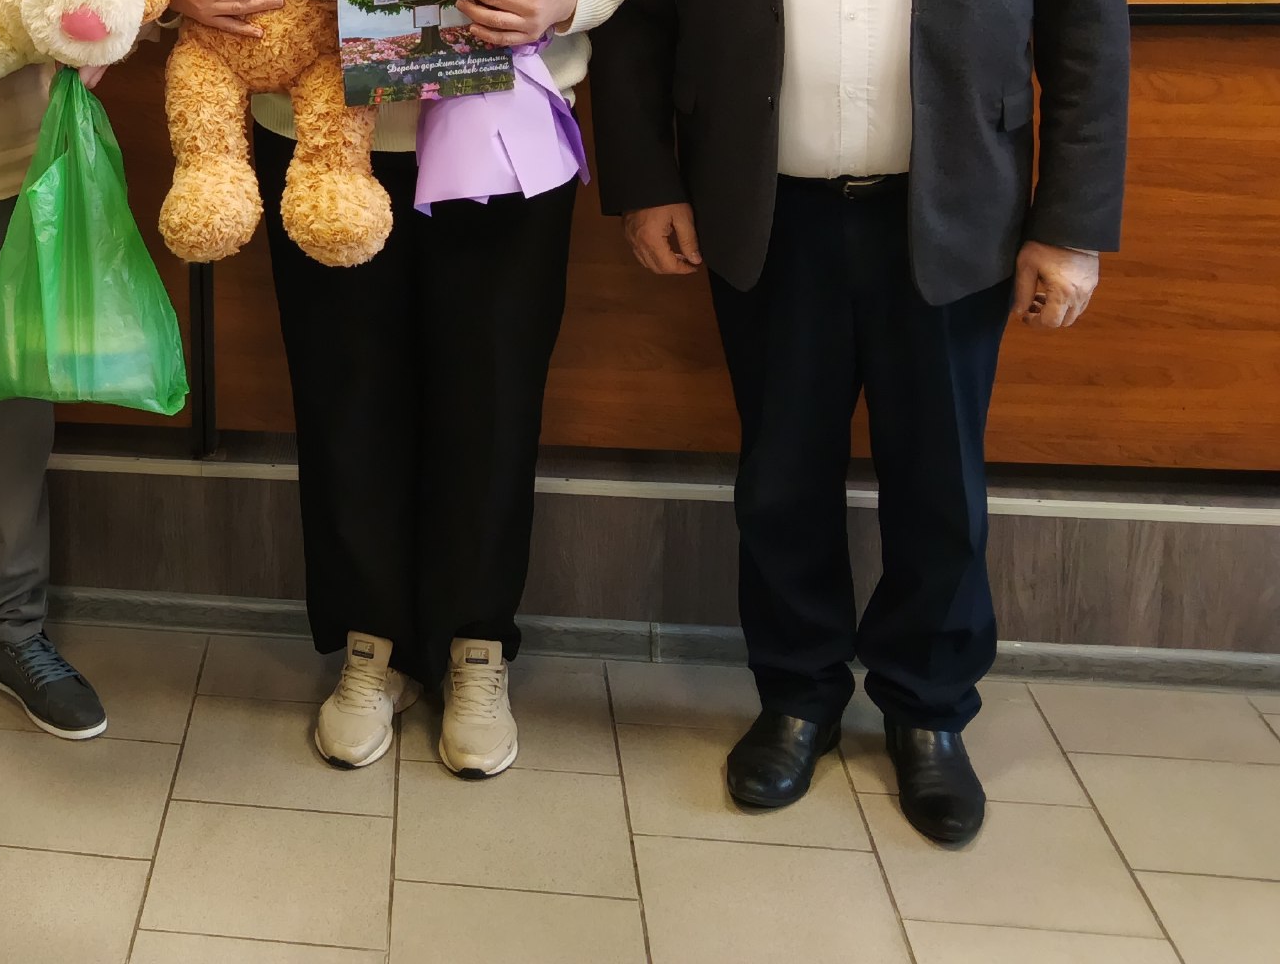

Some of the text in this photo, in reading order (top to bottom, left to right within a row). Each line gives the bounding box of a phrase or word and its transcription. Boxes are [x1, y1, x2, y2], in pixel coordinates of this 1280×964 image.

[387, 61, 420, 74] Дерево
[421, 58, 465, 72] держится
[445, 64, 478, 76] человек
